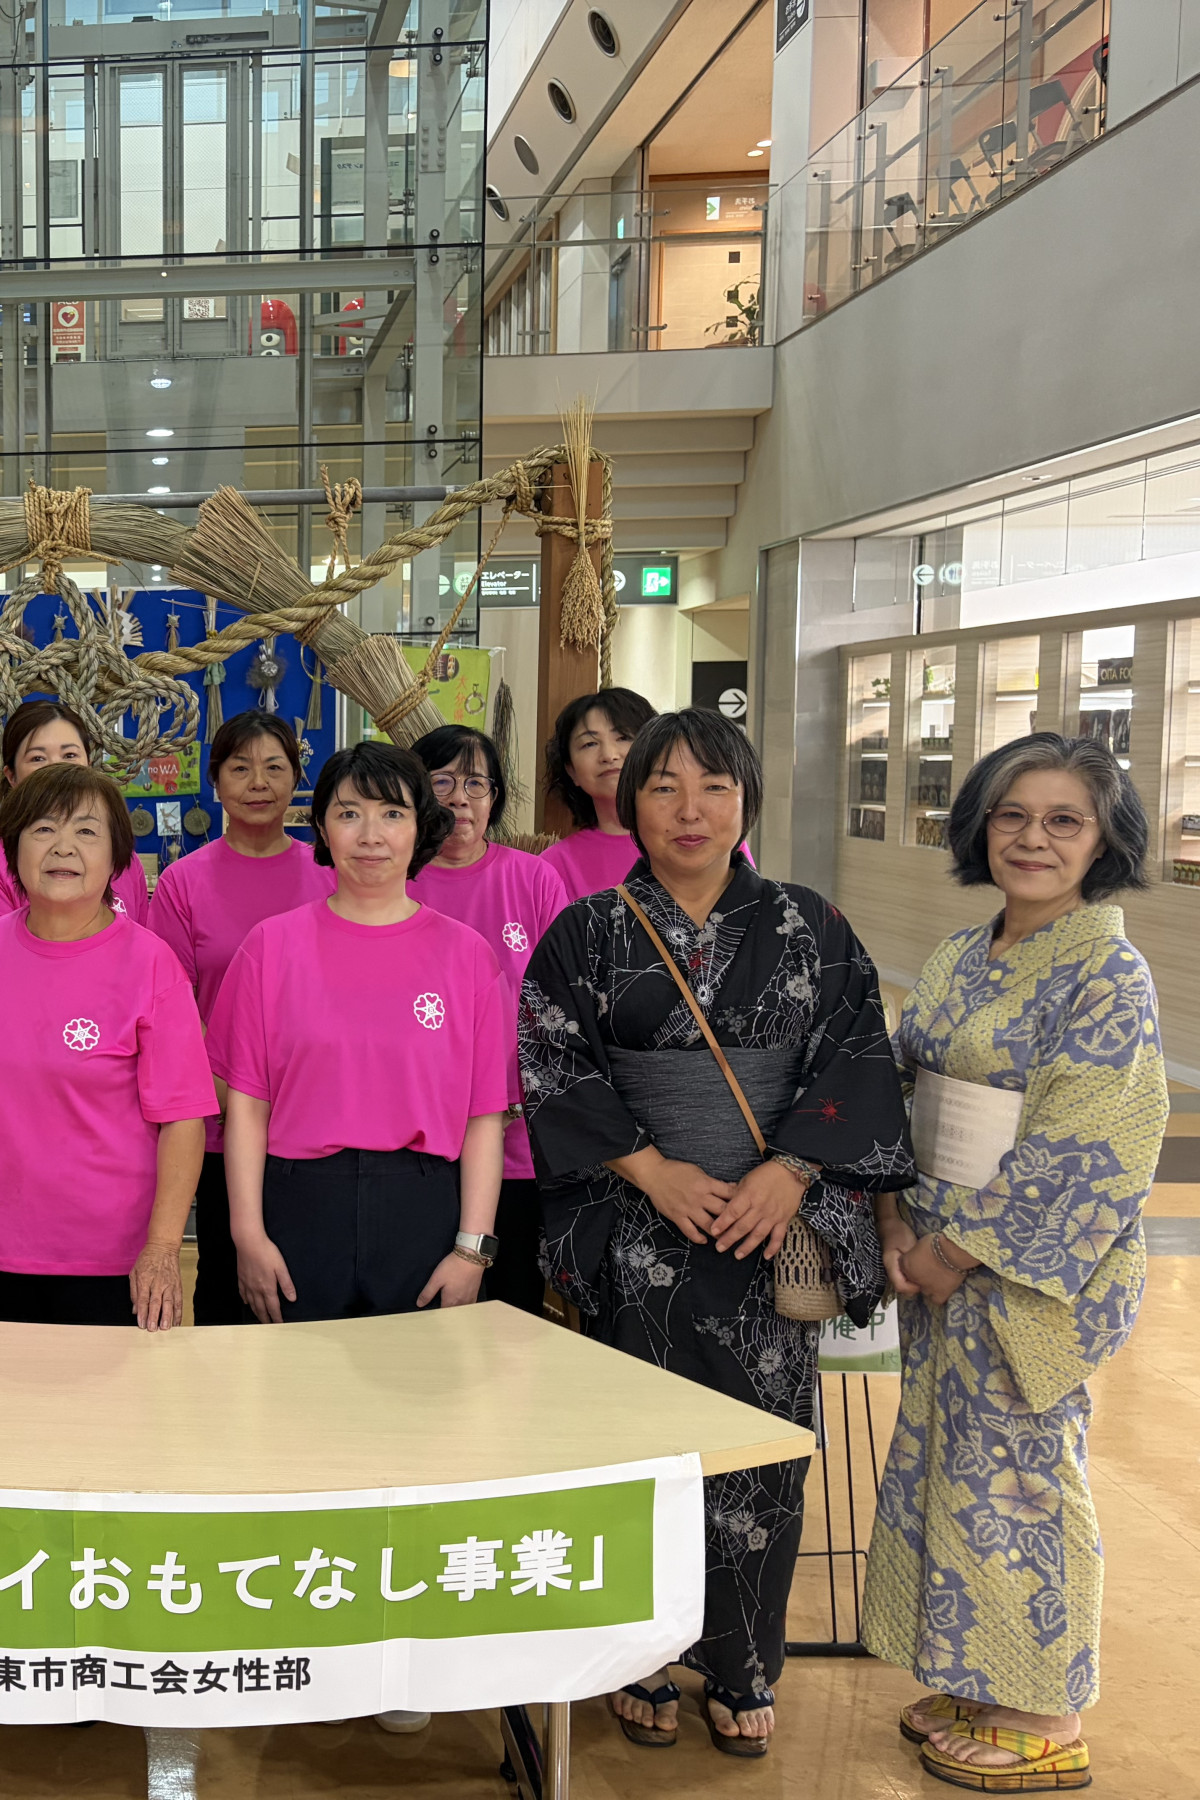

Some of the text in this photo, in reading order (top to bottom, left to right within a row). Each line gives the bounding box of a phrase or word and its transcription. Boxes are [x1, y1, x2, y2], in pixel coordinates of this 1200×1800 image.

[481, 570, 530, 580] エレベーター
[1100, 668, 1118, 681] OITA
